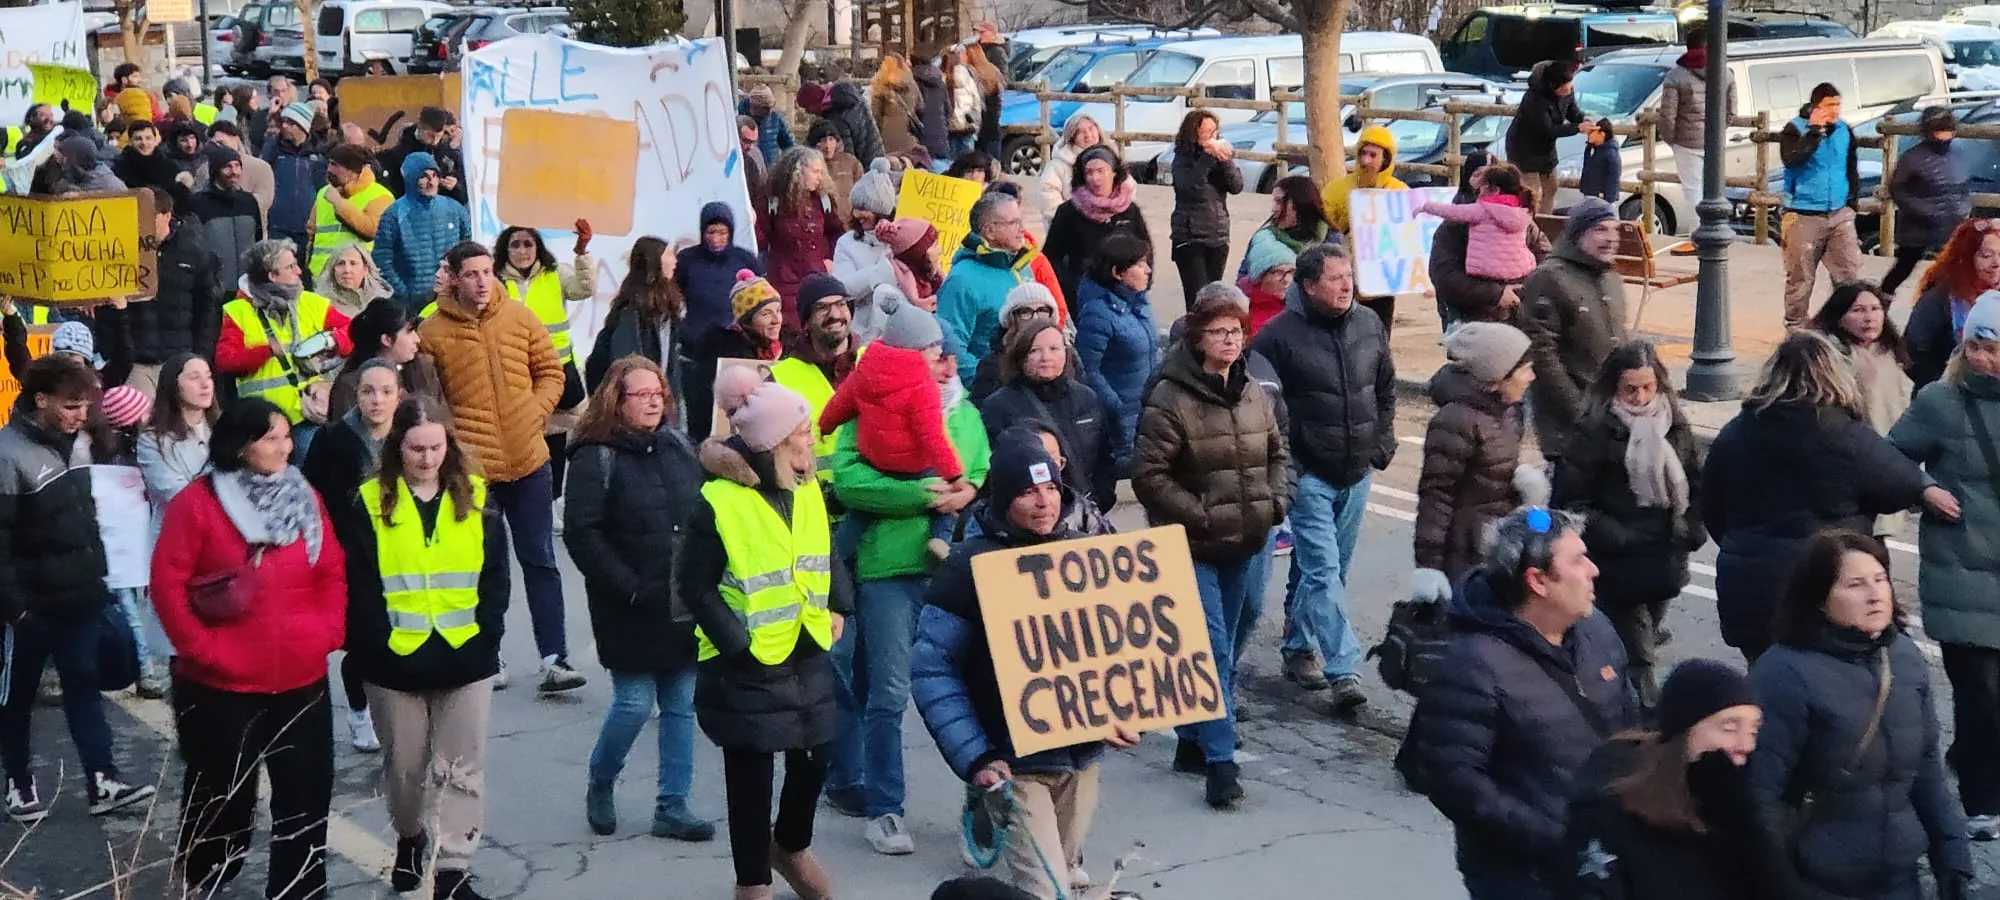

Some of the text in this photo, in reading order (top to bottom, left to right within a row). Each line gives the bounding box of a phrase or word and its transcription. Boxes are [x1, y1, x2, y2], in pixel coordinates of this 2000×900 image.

[914, 174, 961, 202] VALLE
[35, 237, 126, 262] ESCUCHA
[18, 262, 47, 292] FP
[1016, 540, 1160, 600] TODOS
[1013, 594, 1181, 674] UNIDOS
[1019, 651, 1219, 735] CRECEMOS
